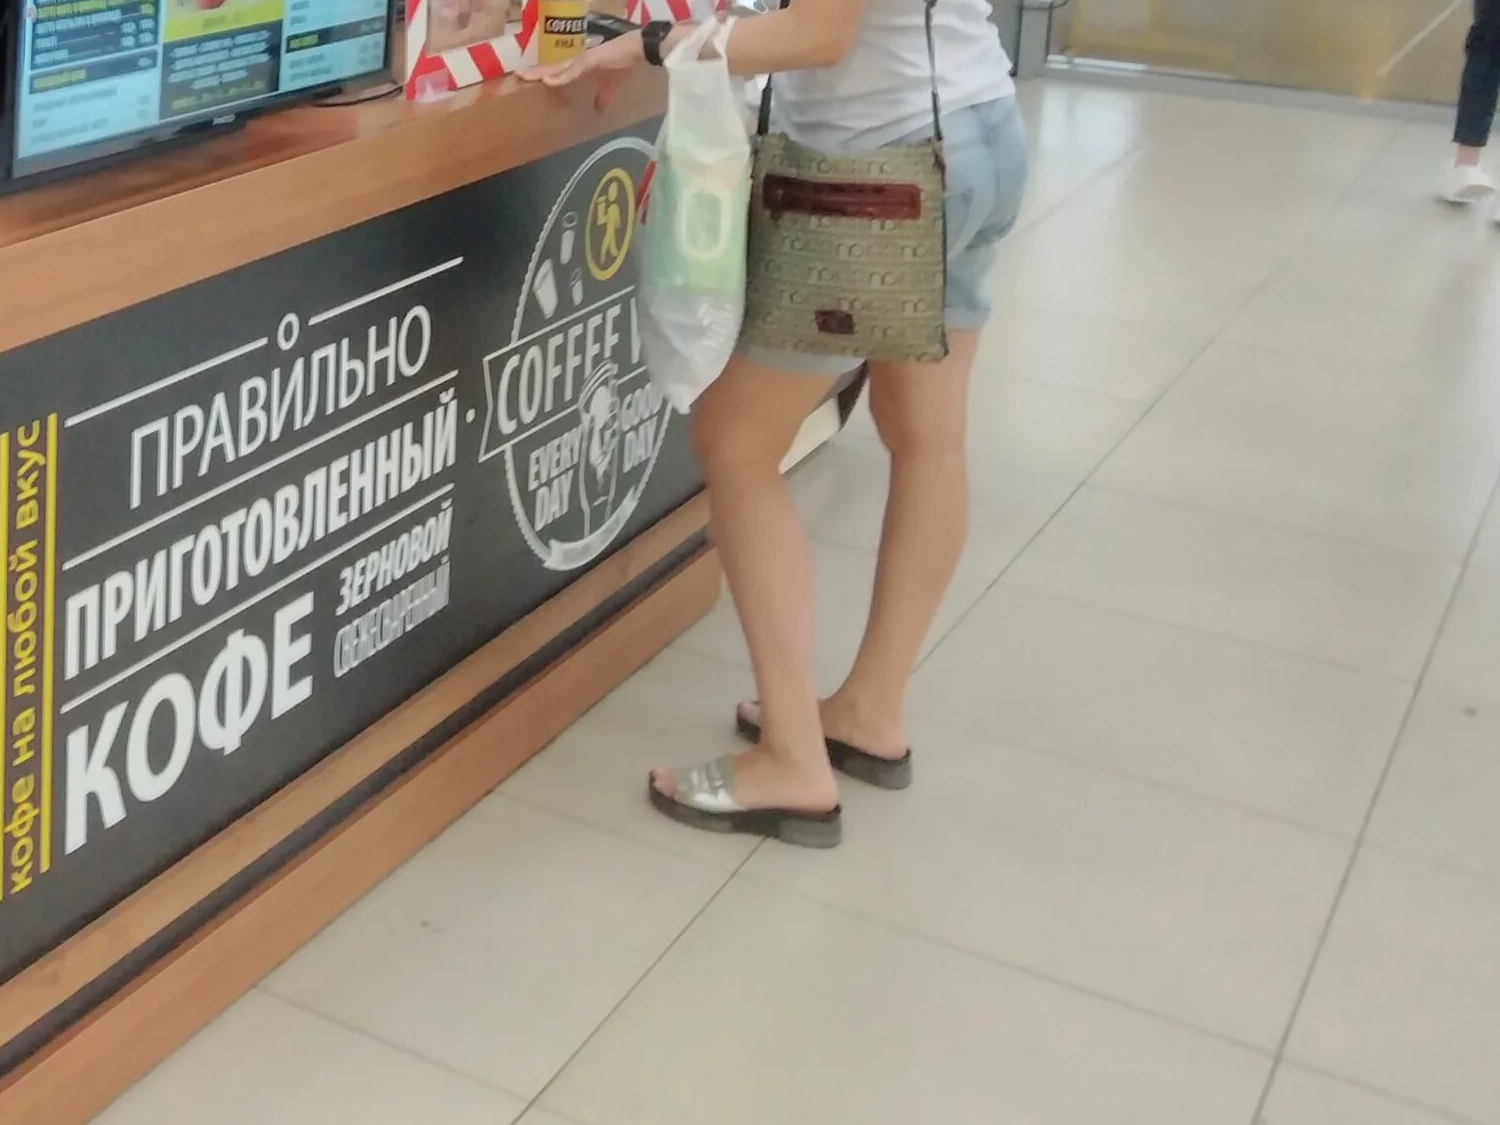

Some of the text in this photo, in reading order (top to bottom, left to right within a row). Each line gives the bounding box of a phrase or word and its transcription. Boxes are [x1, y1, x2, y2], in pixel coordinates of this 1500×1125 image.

[130, 305, 431, 509] ПРАВИЛЬНО
[528, 428, 582, 491] EVERY
[622, 415, 658, 473] DAY
[65, 387, 458, 681] ПРИГОТОВЛЕННЫЙ
[335, 498, 453, 616] ЗЕРНОВОЙ
[534, 469, 574, 531] DAY
[3, 419, 47, 895] кофе на любой вкус
[65, 591, 315, 856] КОФЕ
